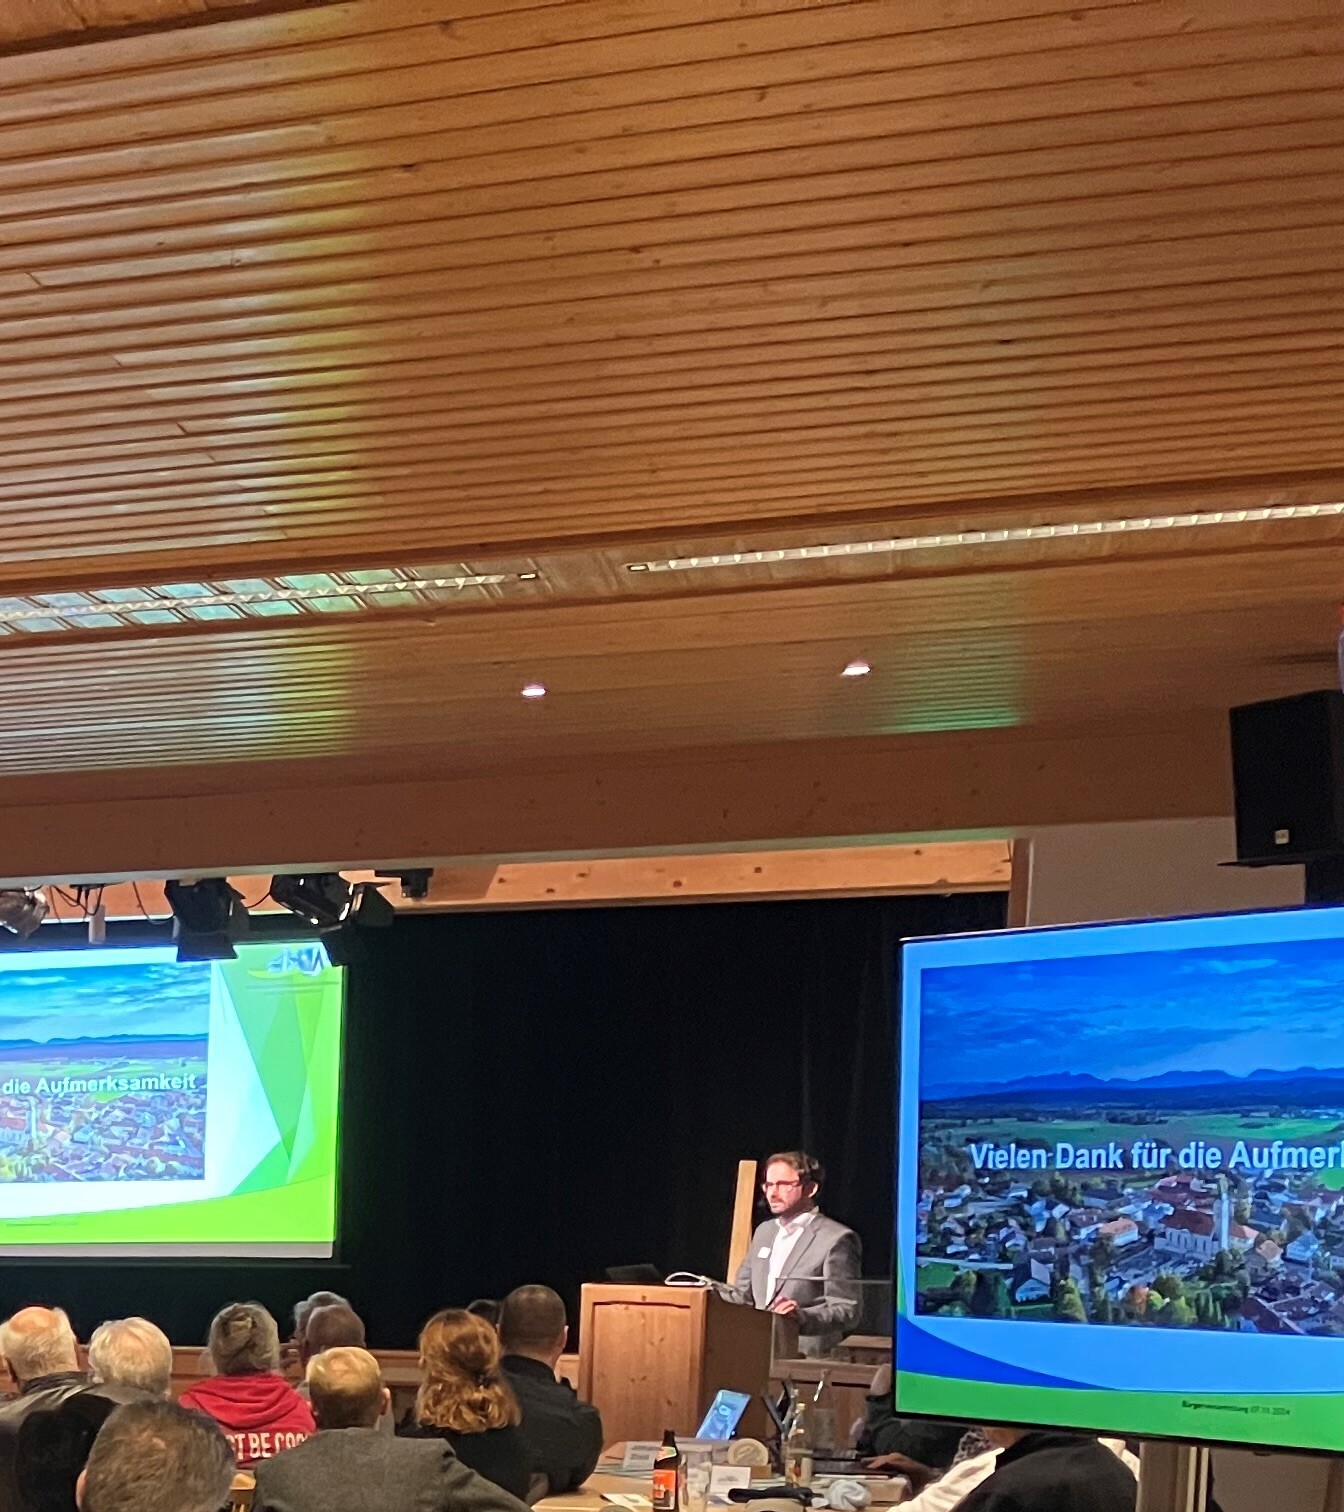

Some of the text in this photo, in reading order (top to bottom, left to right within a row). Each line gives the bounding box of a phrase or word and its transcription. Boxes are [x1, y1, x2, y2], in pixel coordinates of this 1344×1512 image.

[2, 1078, 31, 1095] die
[35, 1073, 197, 1095] Aufmerksamkeit
[970, 1143, 1047, 1169] Vielen
[1055, 1142, 1124, 1170] Dank
[1130, 1141, 1172, 1169] für
[1178, 1141, 1222, 1169] die
[247, 1433, 272, 1459] BE
